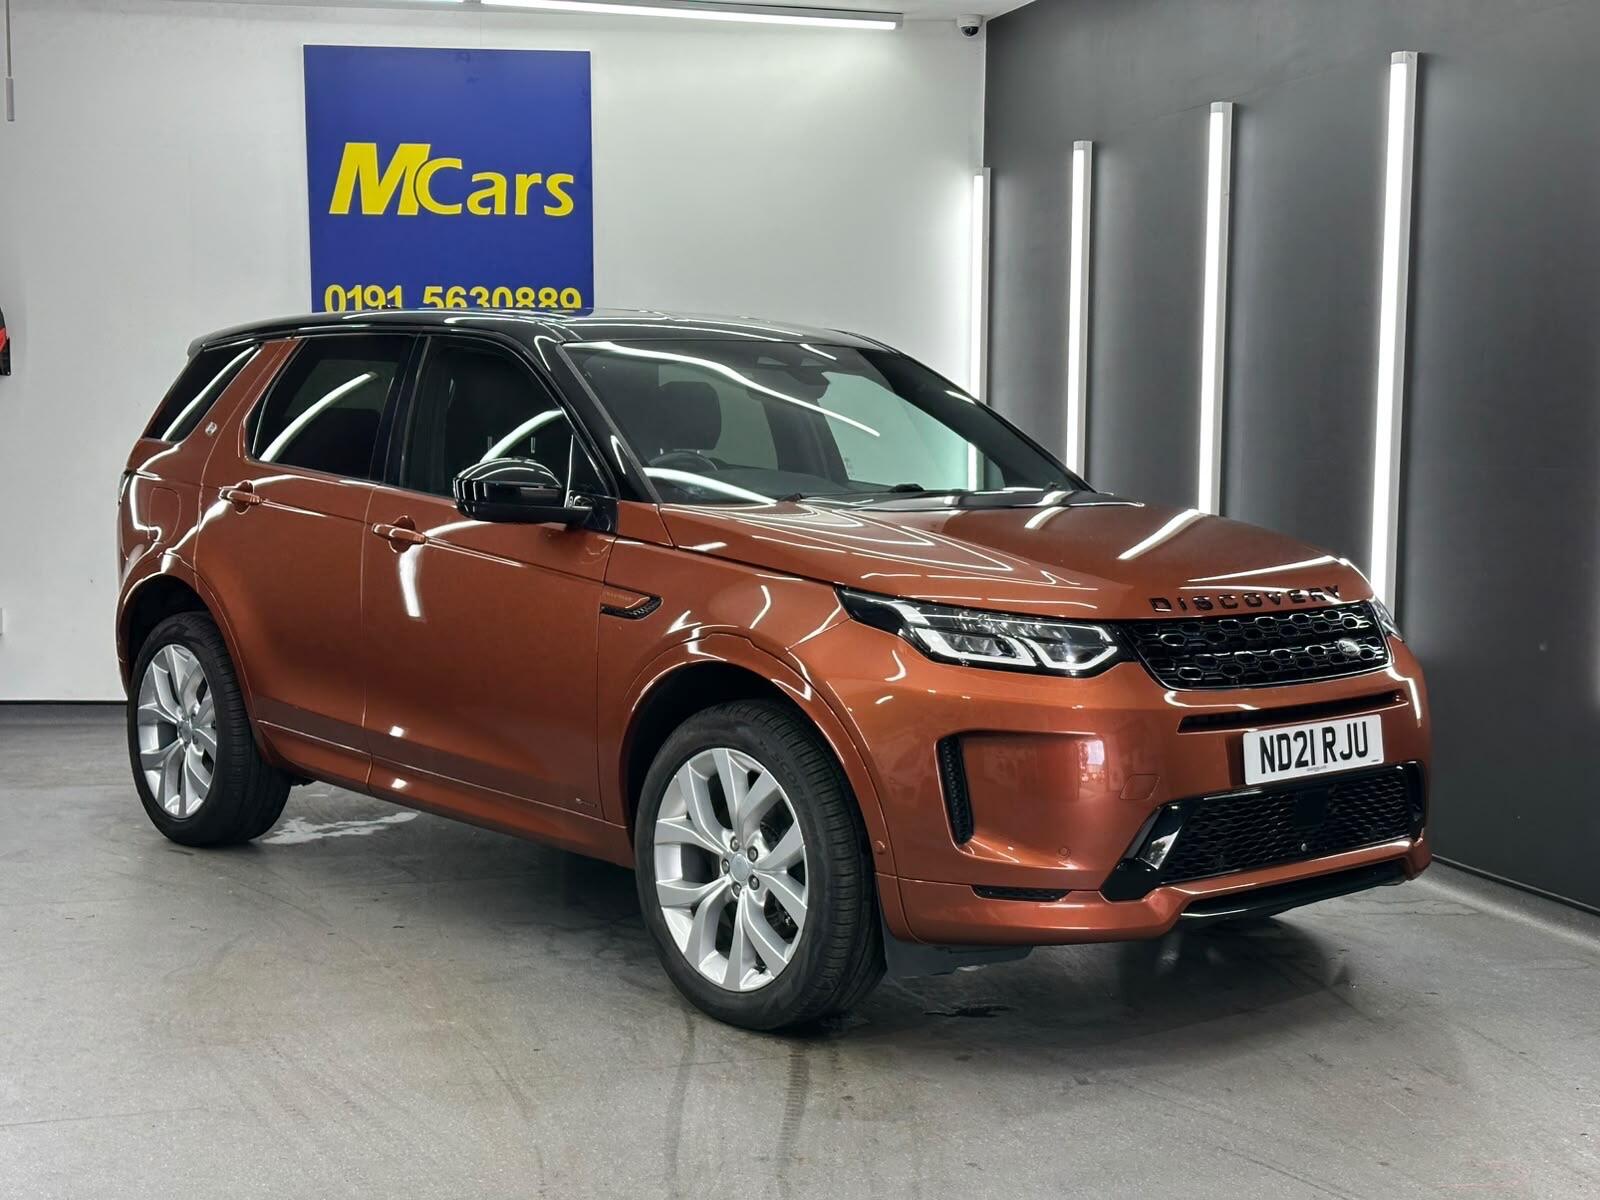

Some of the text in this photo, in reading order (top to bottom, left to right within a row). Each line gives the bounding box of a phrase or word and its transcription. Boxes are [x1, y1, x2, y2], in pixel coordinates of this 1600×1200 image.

[324, 284, 583, 313] 0191 5630889
[1149, 584, 1340, 613] DISCOVERY
[1259, 721, 1369, 774] ND21 RJU
